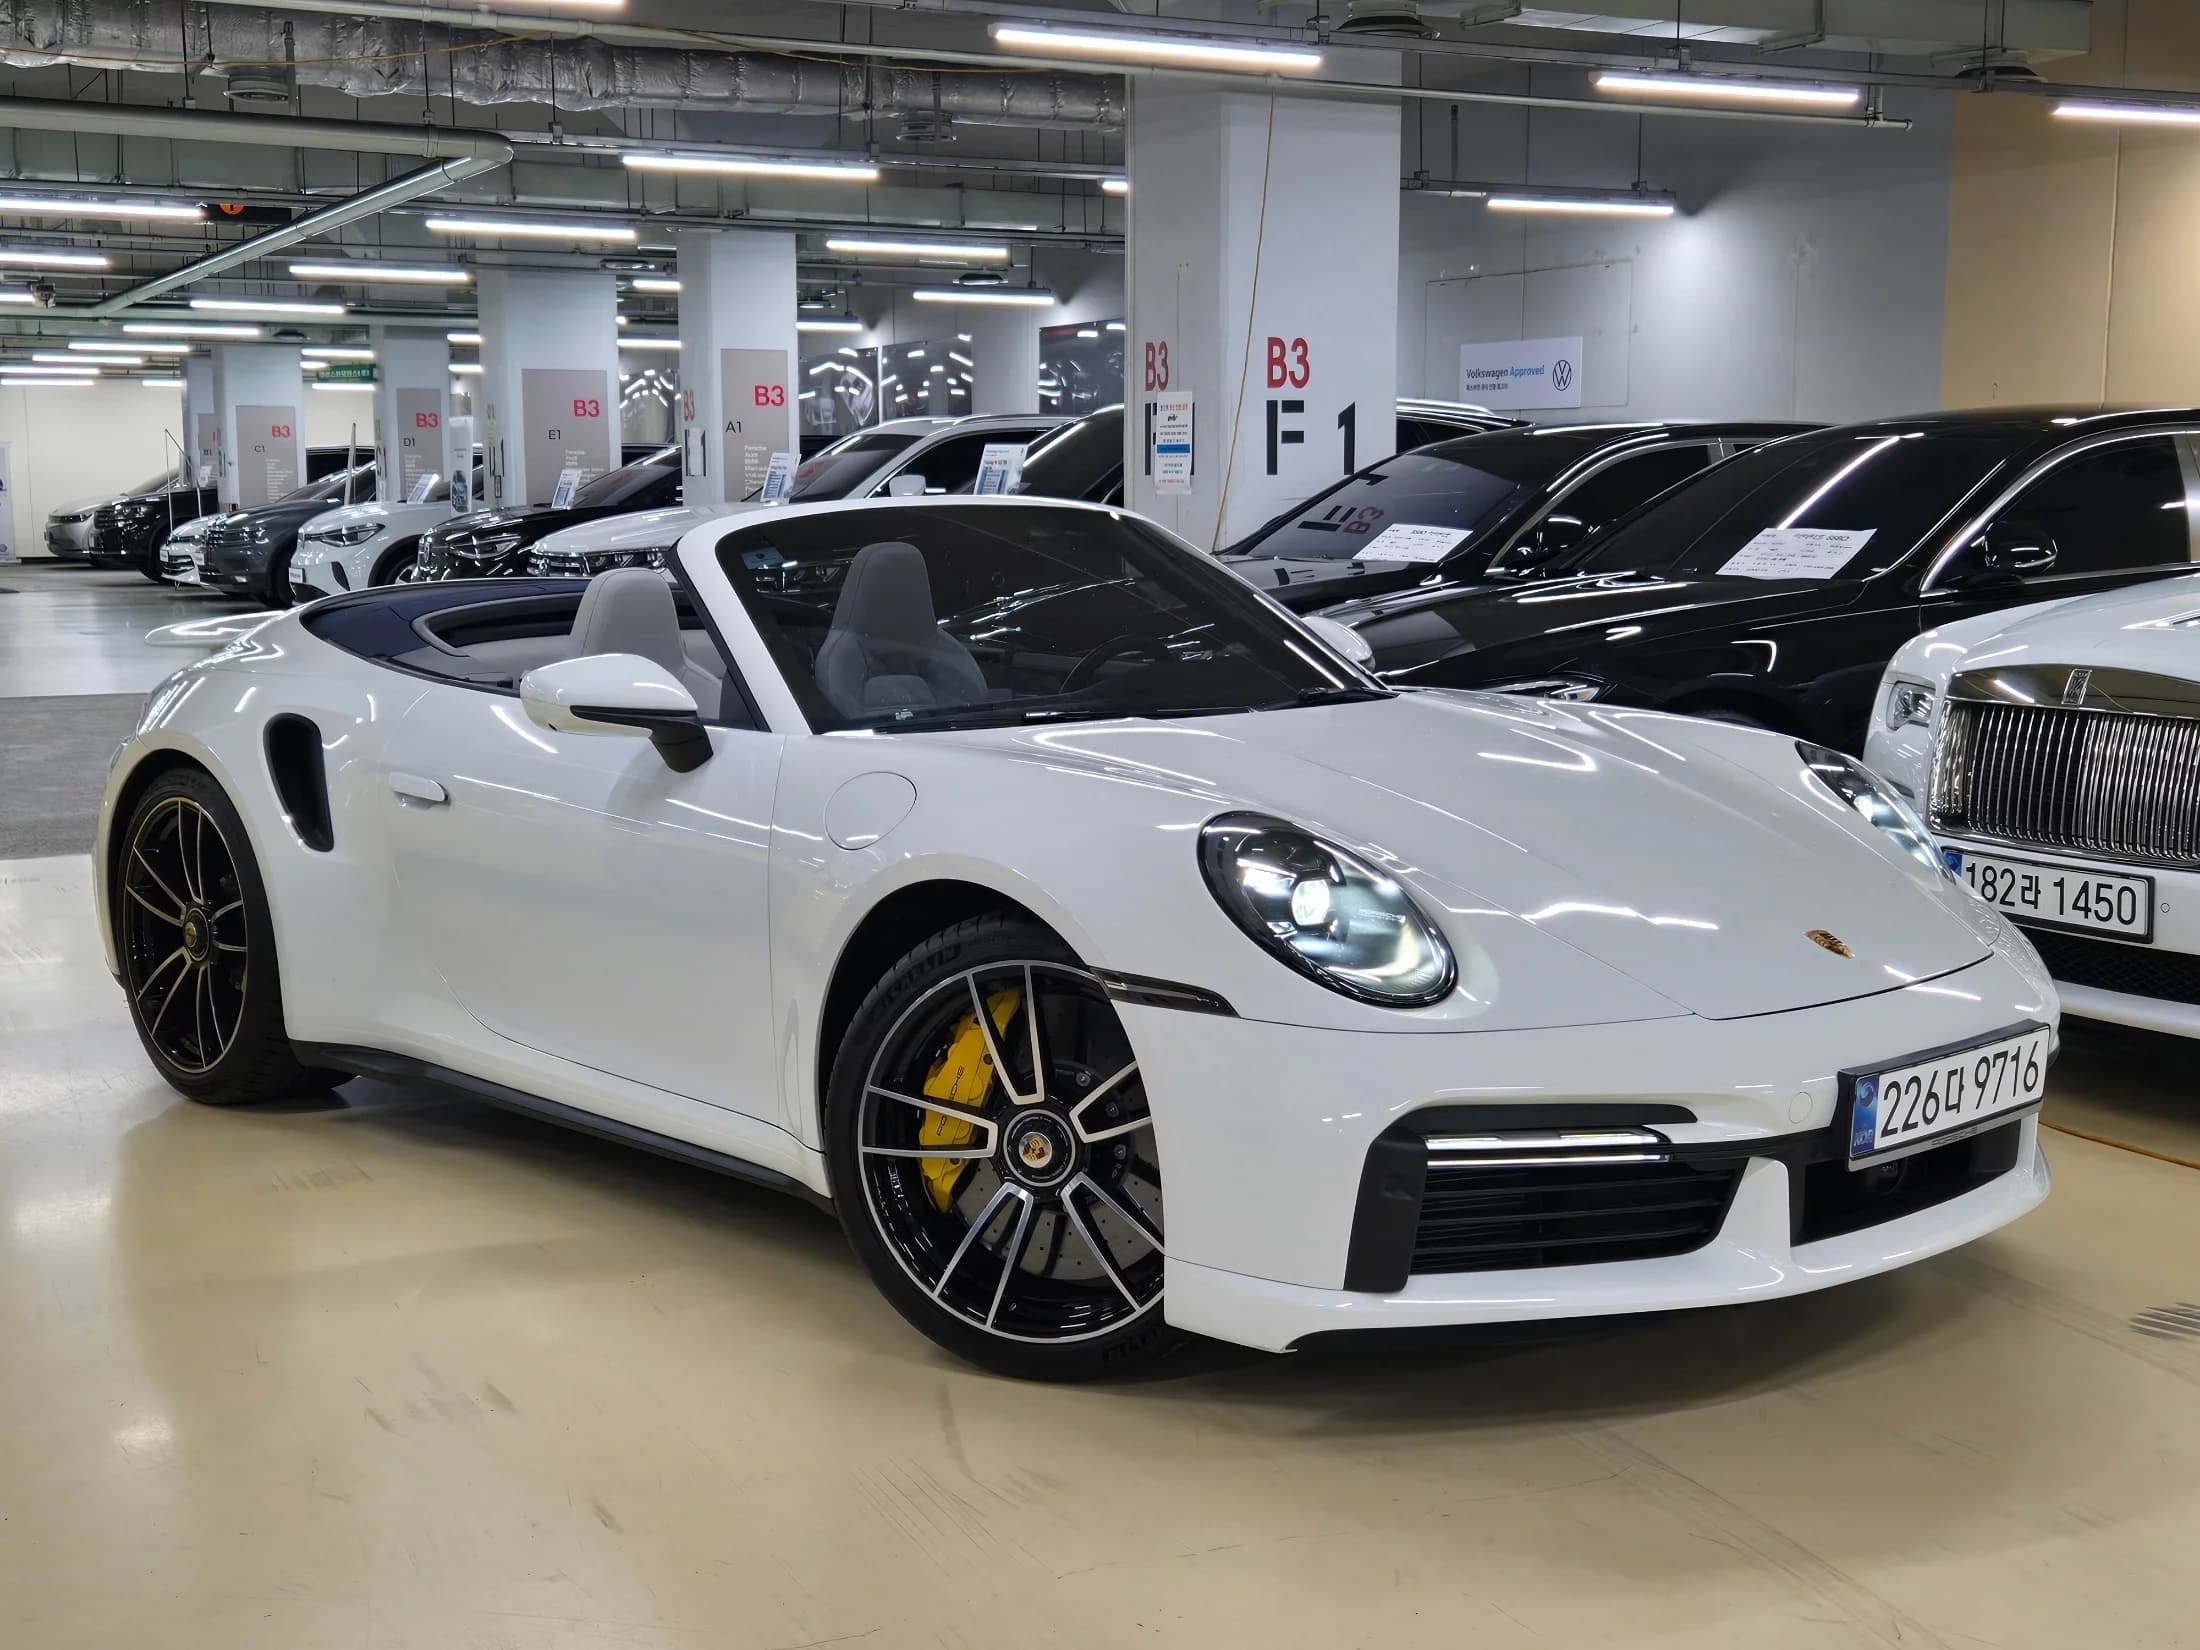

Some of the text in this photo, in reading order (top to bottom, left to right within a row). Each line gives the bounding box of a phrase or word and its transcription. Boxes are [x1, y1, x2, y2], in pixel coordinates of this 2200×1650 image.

[1144, 340, 1169, 391] B3
[1266, 336, 1310, 389] B3
[1466, 364, 1545, 380] Volkswagen Approved
[754, 384, 785, 407] B3
[573, 399, 600, 418] B3
[415, 412, 439, 429] B3
[725, 421, 742, 433] A1
[272, 425, 290, 439] B3
[548, 429, 561, 440] E1
[254, 444, 266, 453] C1
[403, 437, 416, 450] D1
[1965, 861, 2137, 926] 182라 1450
[1881, 1040, 2040, 1138] 226다 9716
